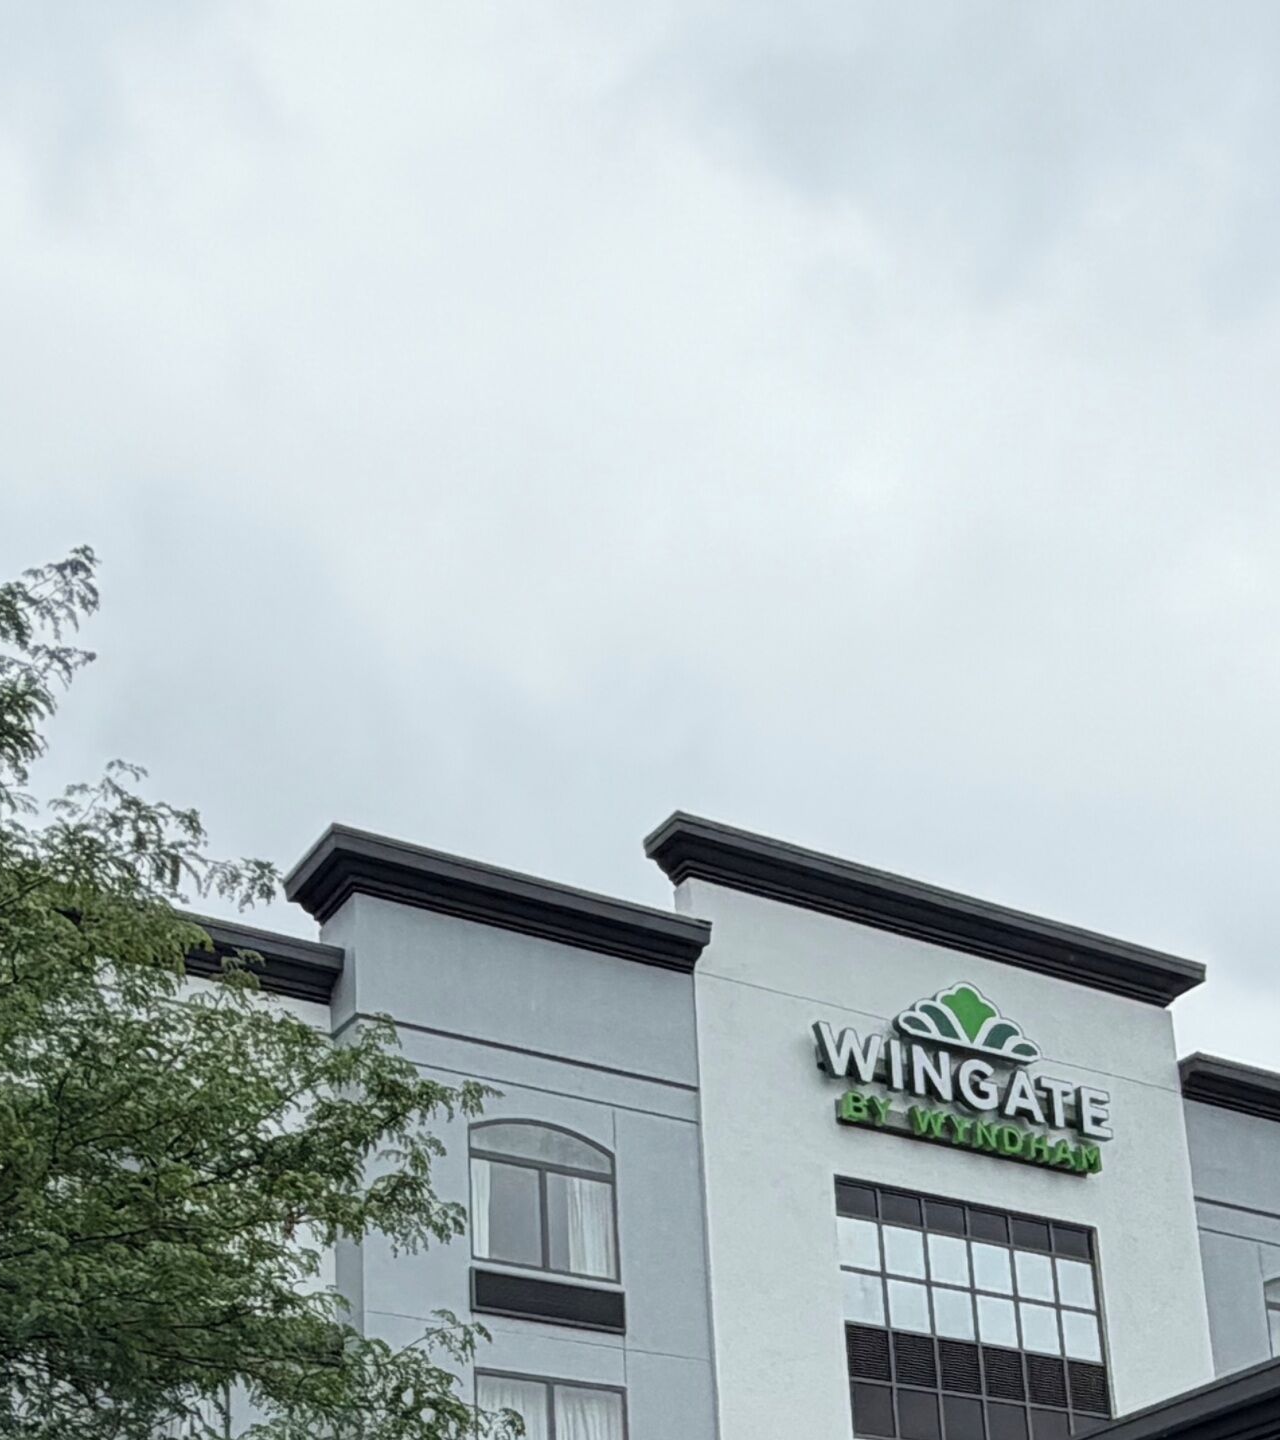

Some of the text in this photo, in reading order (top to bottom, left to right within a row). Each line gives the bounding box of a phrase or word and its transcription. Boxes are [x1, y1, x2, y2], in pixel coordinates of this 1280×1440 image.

[814, 1020, 1113, 1140] WINGATE
[841, 1090, 1102, 1174] BY WYNDHAM
